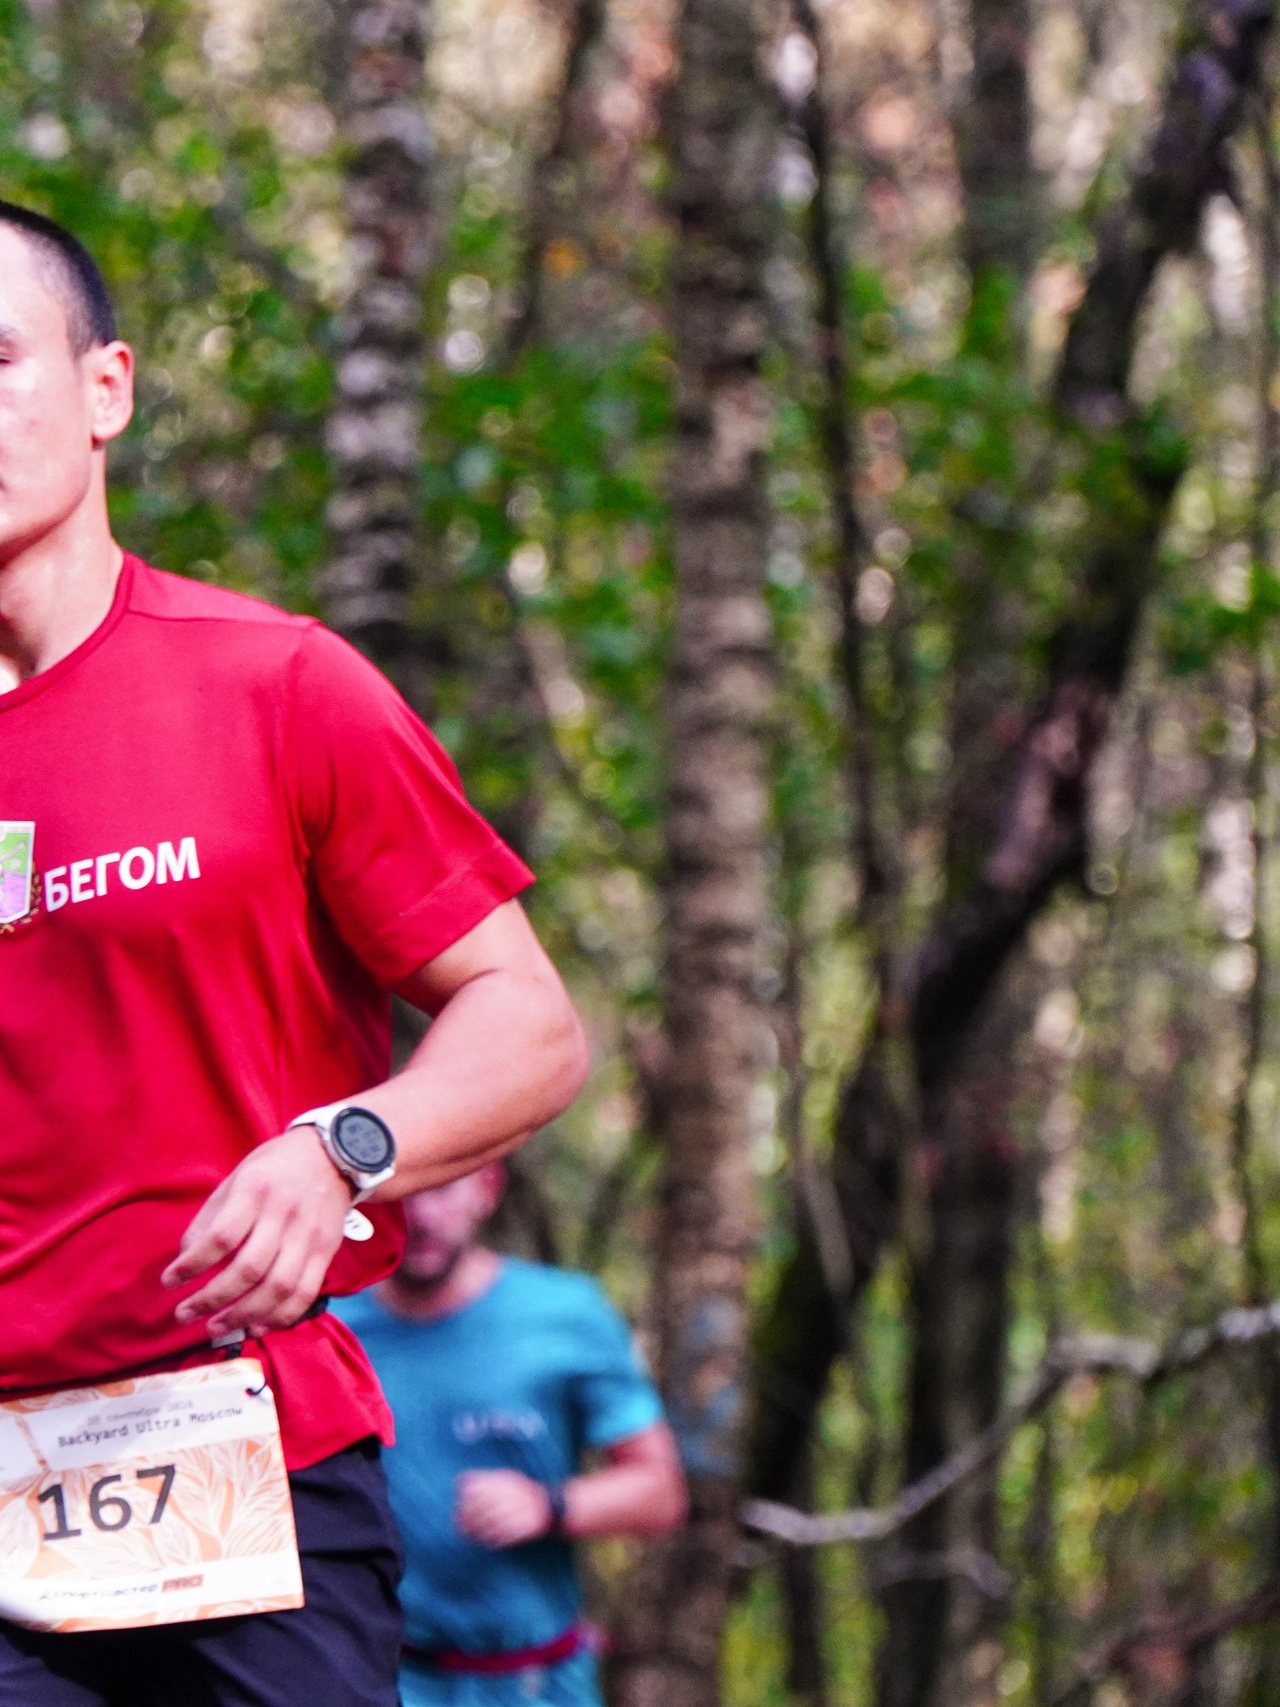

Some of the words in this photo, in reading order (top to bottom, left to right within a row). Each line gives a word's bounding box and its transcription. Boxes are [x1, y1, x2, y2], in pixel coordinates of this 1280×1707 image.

[44, 837, 201, 913] БЕГОМ
[57, 1424, 129, 1448] Backyard
[135, 1418, 182, 1435] Ultra
[189, 1406, 242, 1424] Moscow
[37, 1464, 177, 1542] 167
